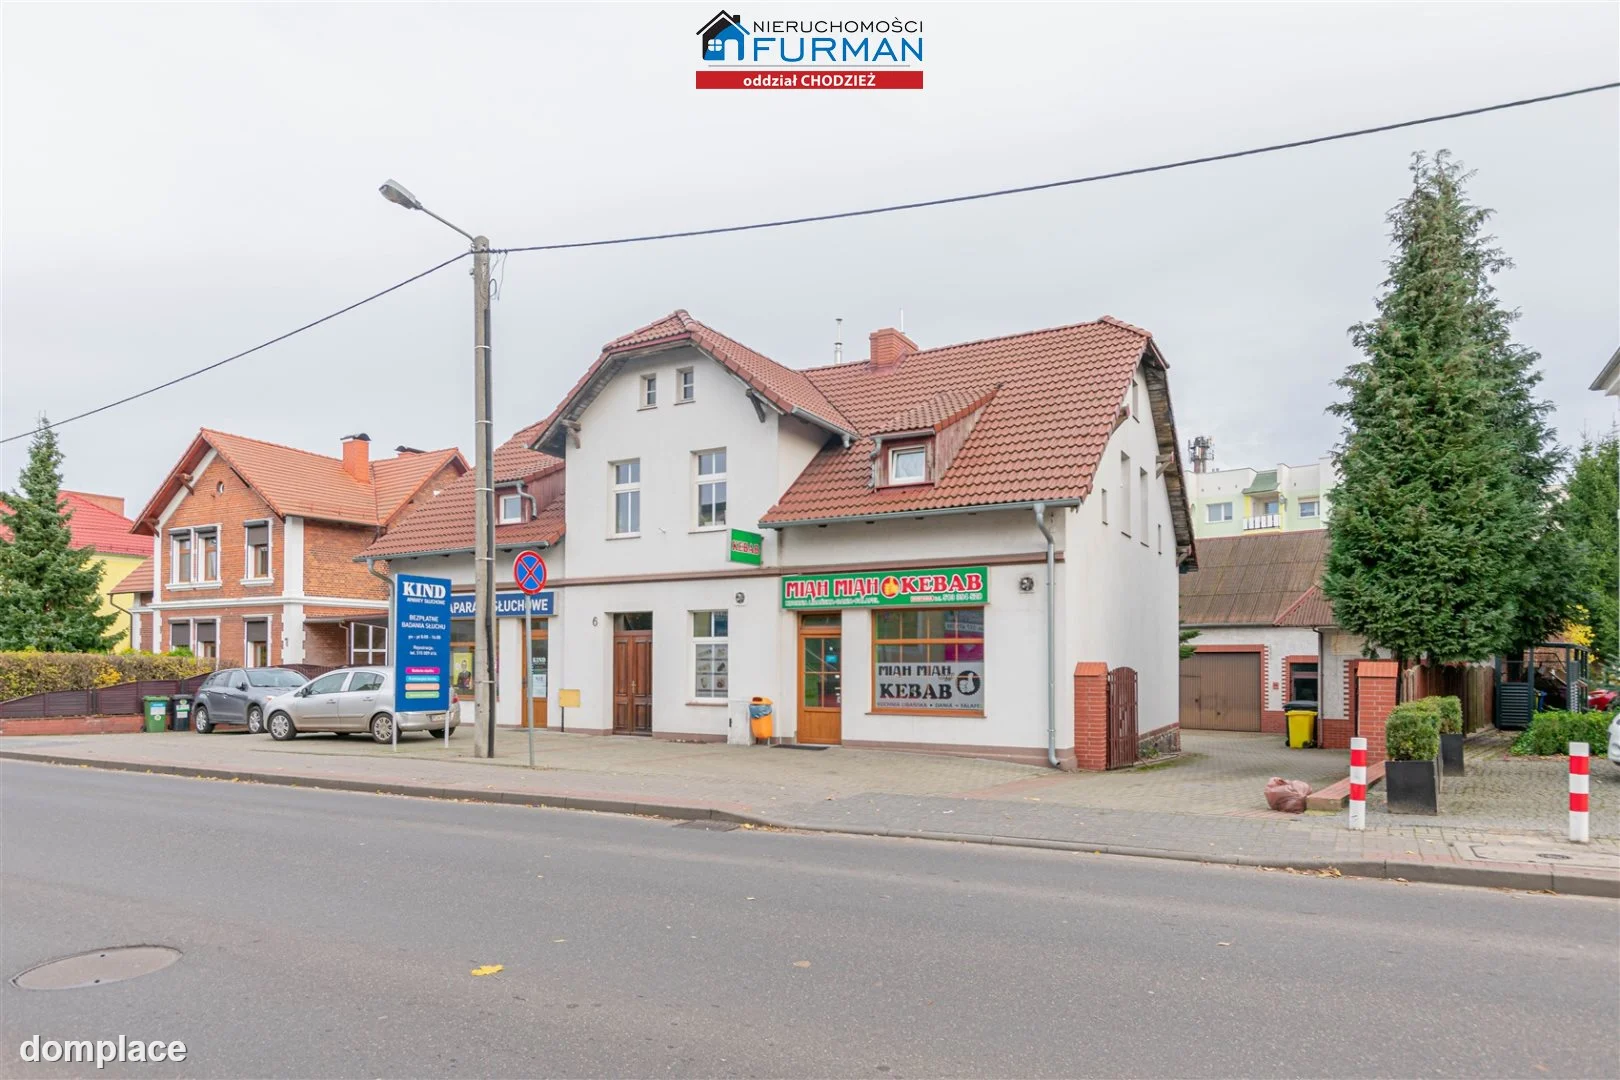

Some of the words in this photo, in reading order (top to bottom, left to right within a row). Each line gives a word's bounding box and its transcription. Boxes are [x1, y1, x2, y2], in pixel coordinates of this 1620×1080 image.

[402, 581, 446, 599] KIND
[901, 574, 983, 594] KEBAB
[592, 617, 598, 627] 6
[880, 683, 953, 699] KEBAB
